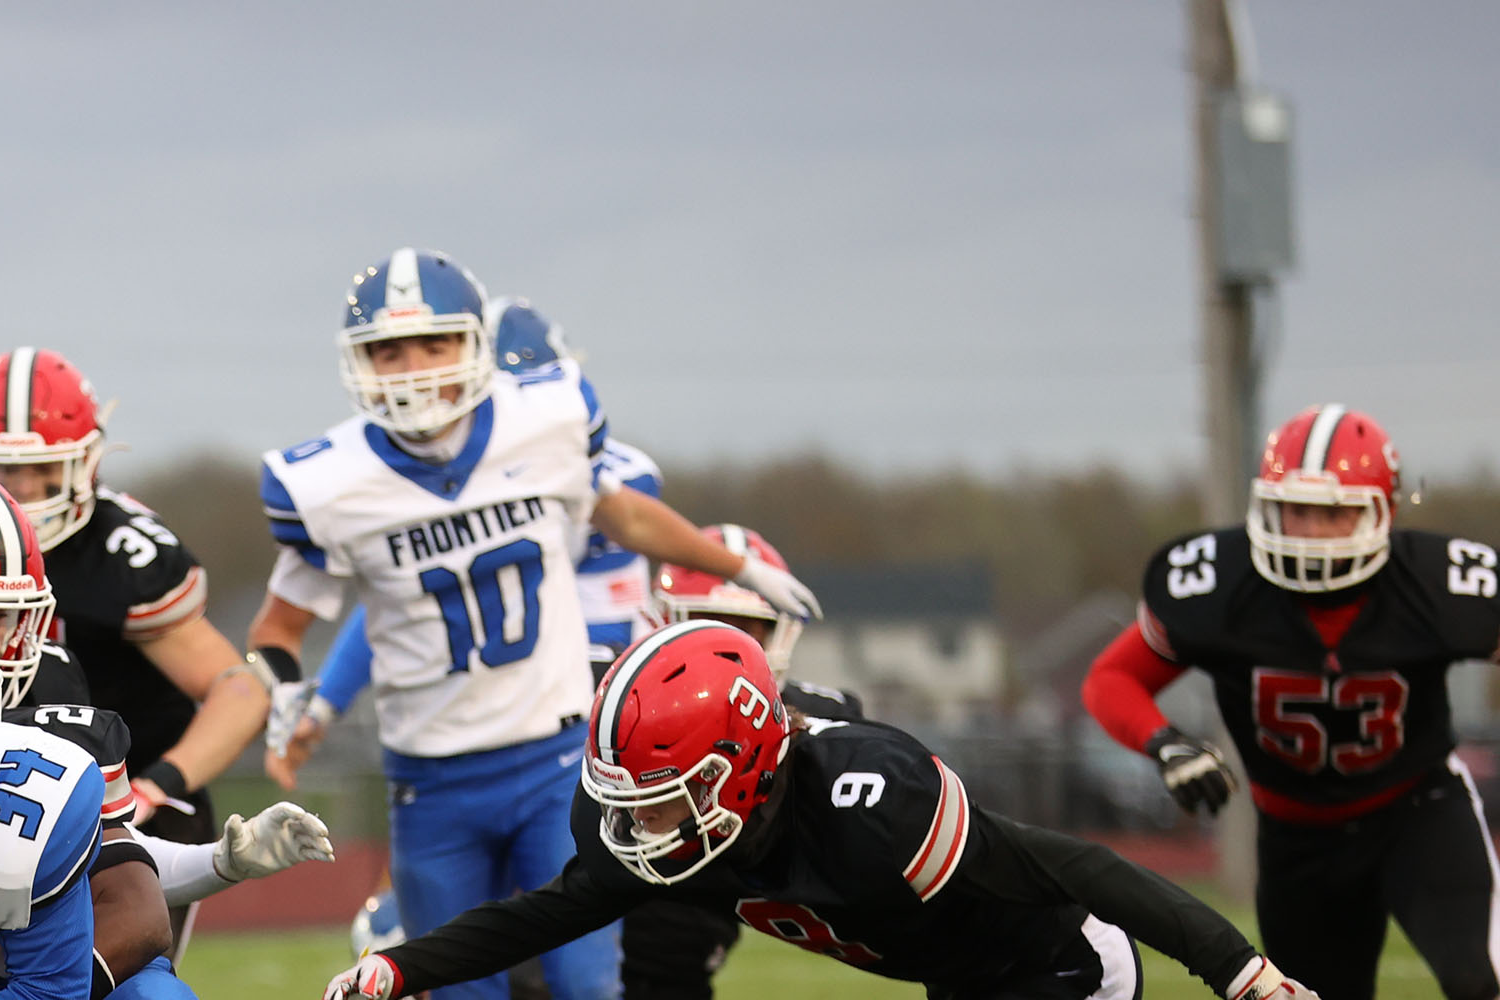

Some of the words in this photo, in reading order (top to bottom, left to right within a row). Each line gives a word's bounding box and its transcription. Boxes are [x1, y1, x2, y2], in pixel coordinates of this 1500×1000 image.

[386, 494, 546, 568] FRONTIER
[1167, 533, 1217, 600] 53
[1447, 537, 1498, 599] 53
[418, 537, 545, 675] 10
[1252, 666, 1410, 776] 53
[831, 771, 886, 809] 9
